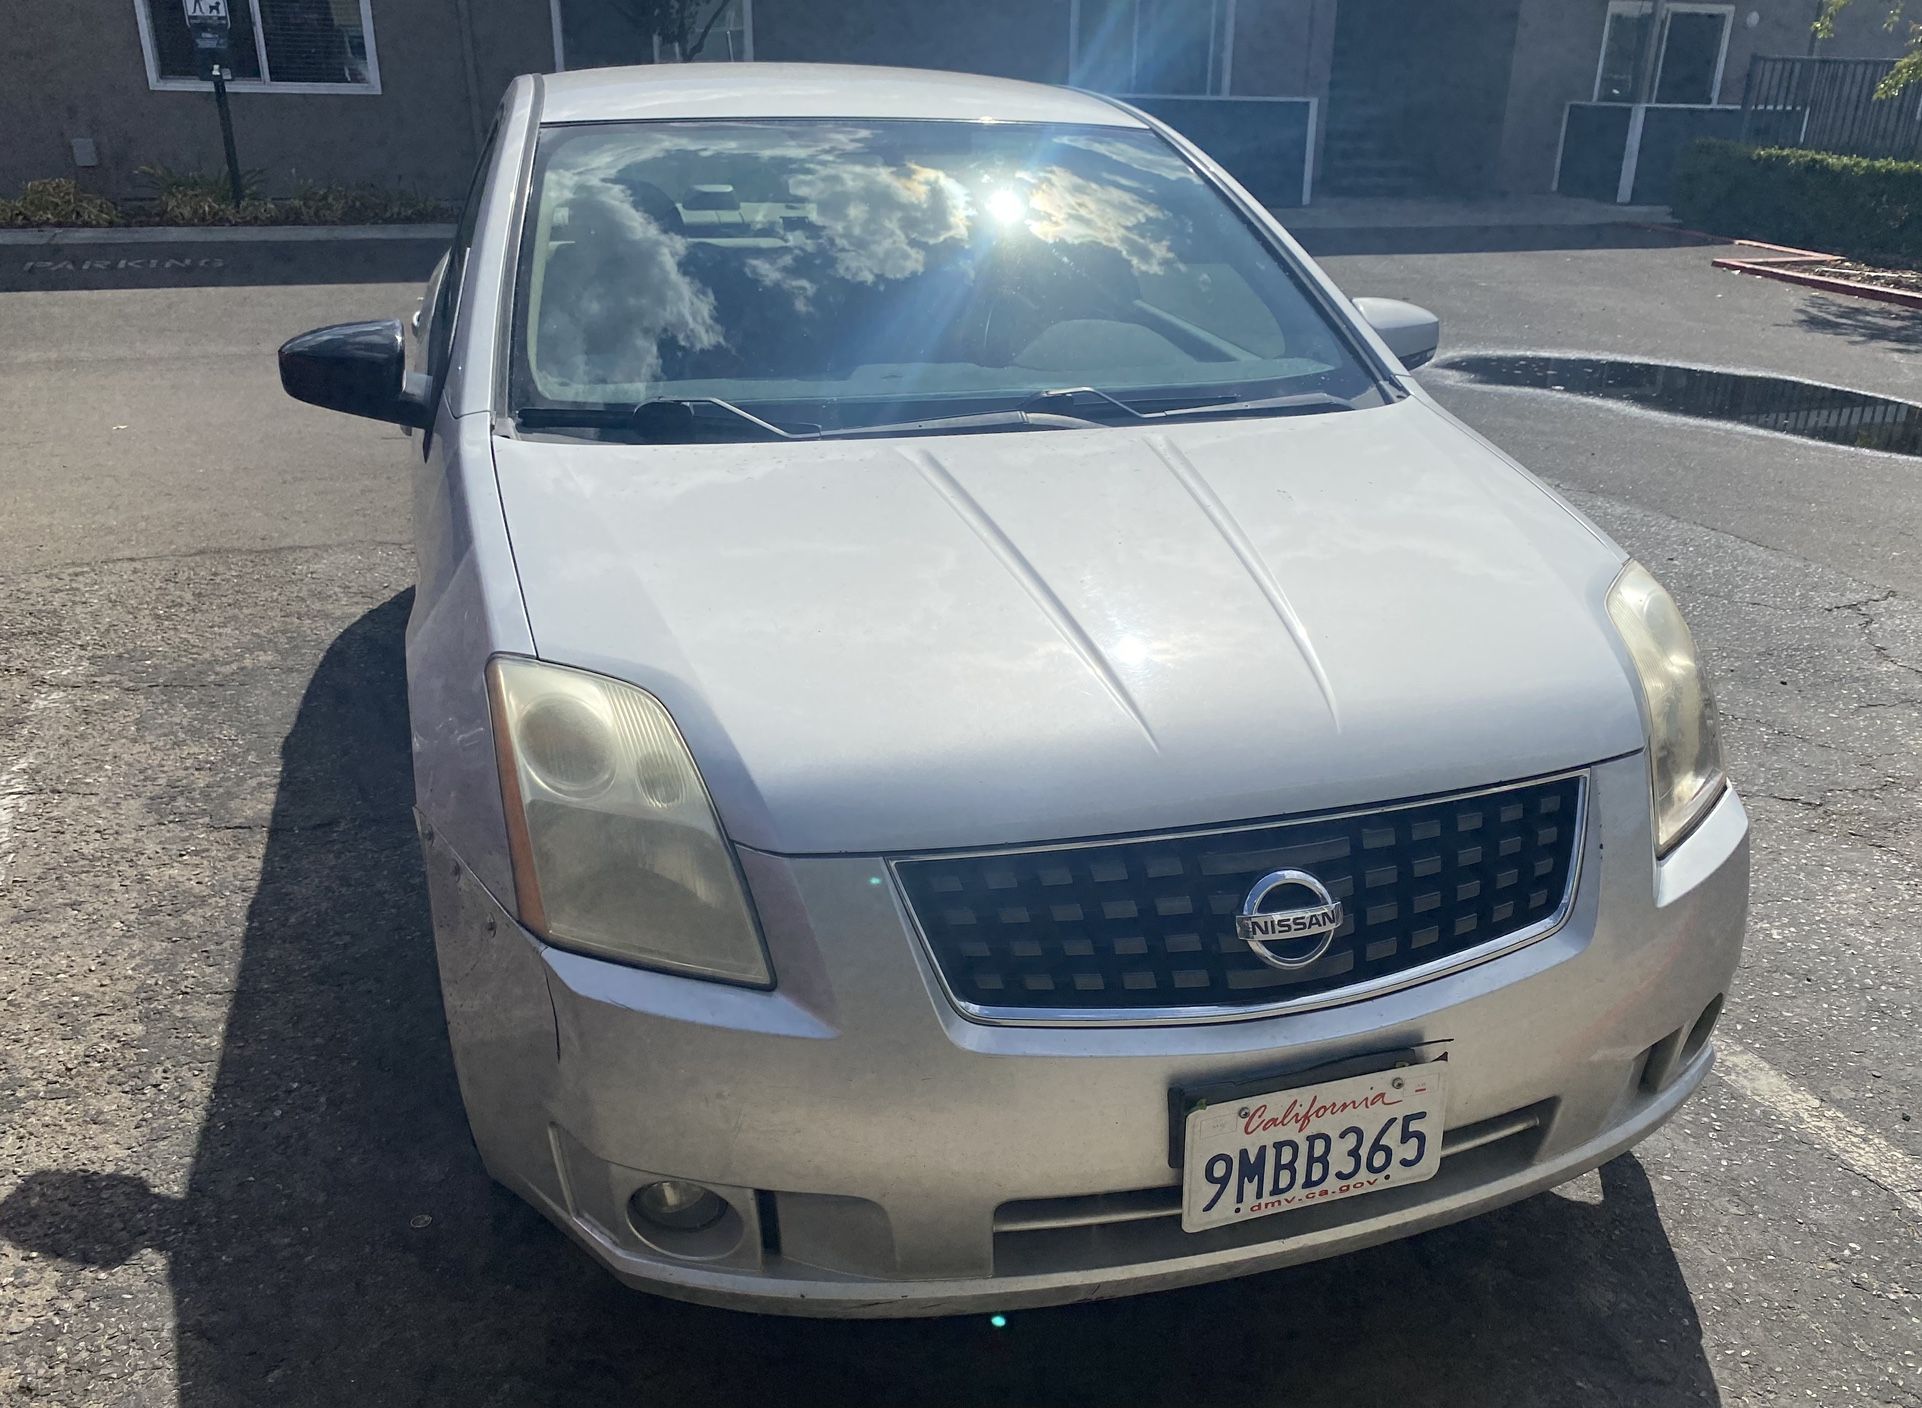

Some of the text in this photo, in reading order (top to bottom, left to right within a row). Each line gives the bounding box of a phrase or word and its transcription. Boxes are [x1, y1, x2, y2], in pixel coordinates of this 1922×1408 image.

[23, 258, 224, 271] PARKING
[1251, 909, 1336, 936] NISSAN
[1244, 1087, 1402, 1136] California
[1202, 1111, 1427, 1213] 9MBB365
[1249, 1177, 1379, 1213] dmv.ca.gov
